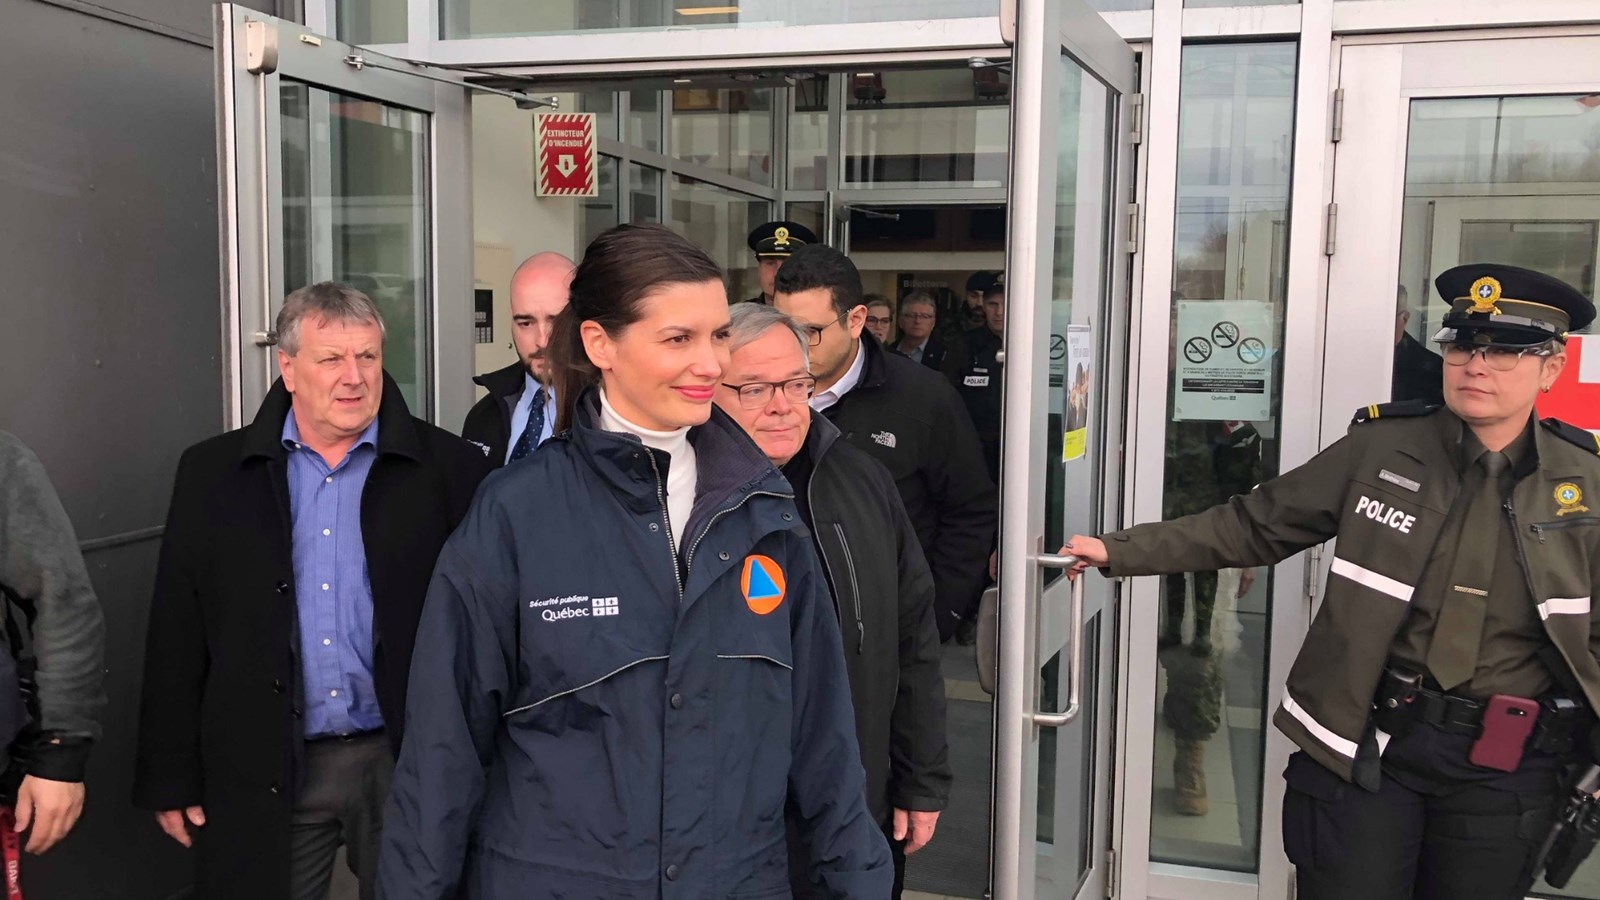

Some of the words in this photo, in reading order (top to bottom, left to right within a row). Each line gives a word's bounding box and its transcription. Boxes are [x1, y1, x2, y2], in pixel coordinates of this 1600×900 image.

[547, 129, 584, 137] EXTINCTEUR
[548, 139, 583, 147] D'INCENDIE
[1354, 495, 1417, 534] POLICE
[529, 596, 559, 608] Sécurité
[559, 594, 589, 605] publique
[541, 606, 590, 622] Québec
